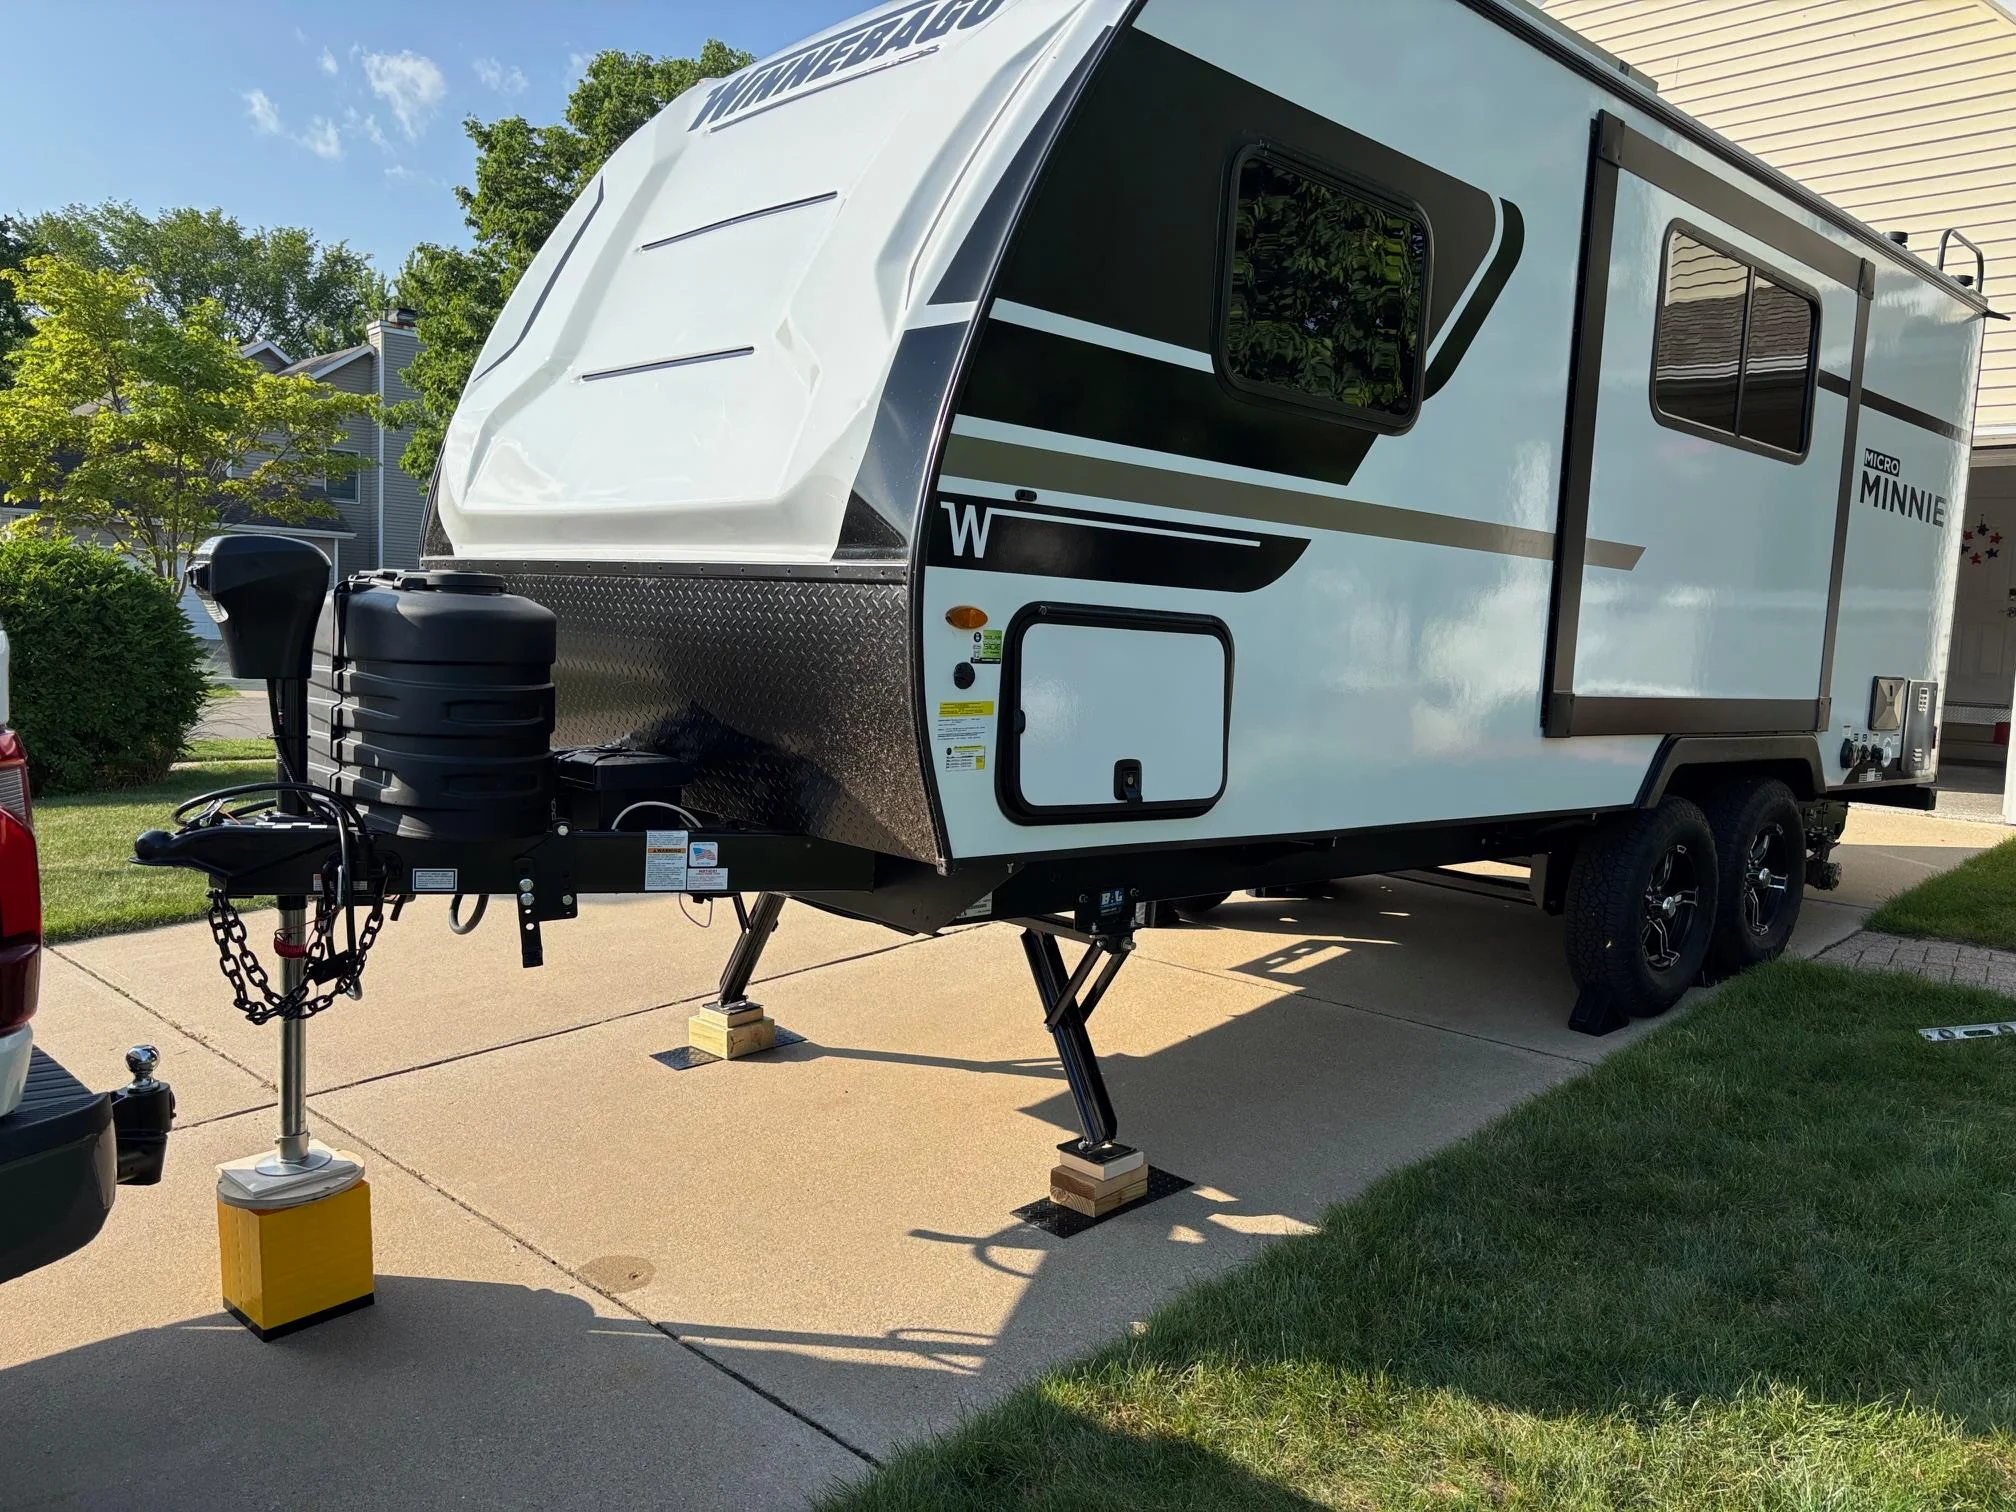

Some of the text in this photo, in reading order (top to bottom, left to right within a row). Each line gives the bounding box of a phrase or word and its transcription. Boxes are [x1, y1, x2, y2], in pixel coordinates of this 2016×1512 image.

[687, 0, 1005, 132] WINNEBAGO
[1865, 450, 1899, 474] MICRO
[1860, 470, 1946, 527] MINNIE
[940, 501, 993, 559] W
